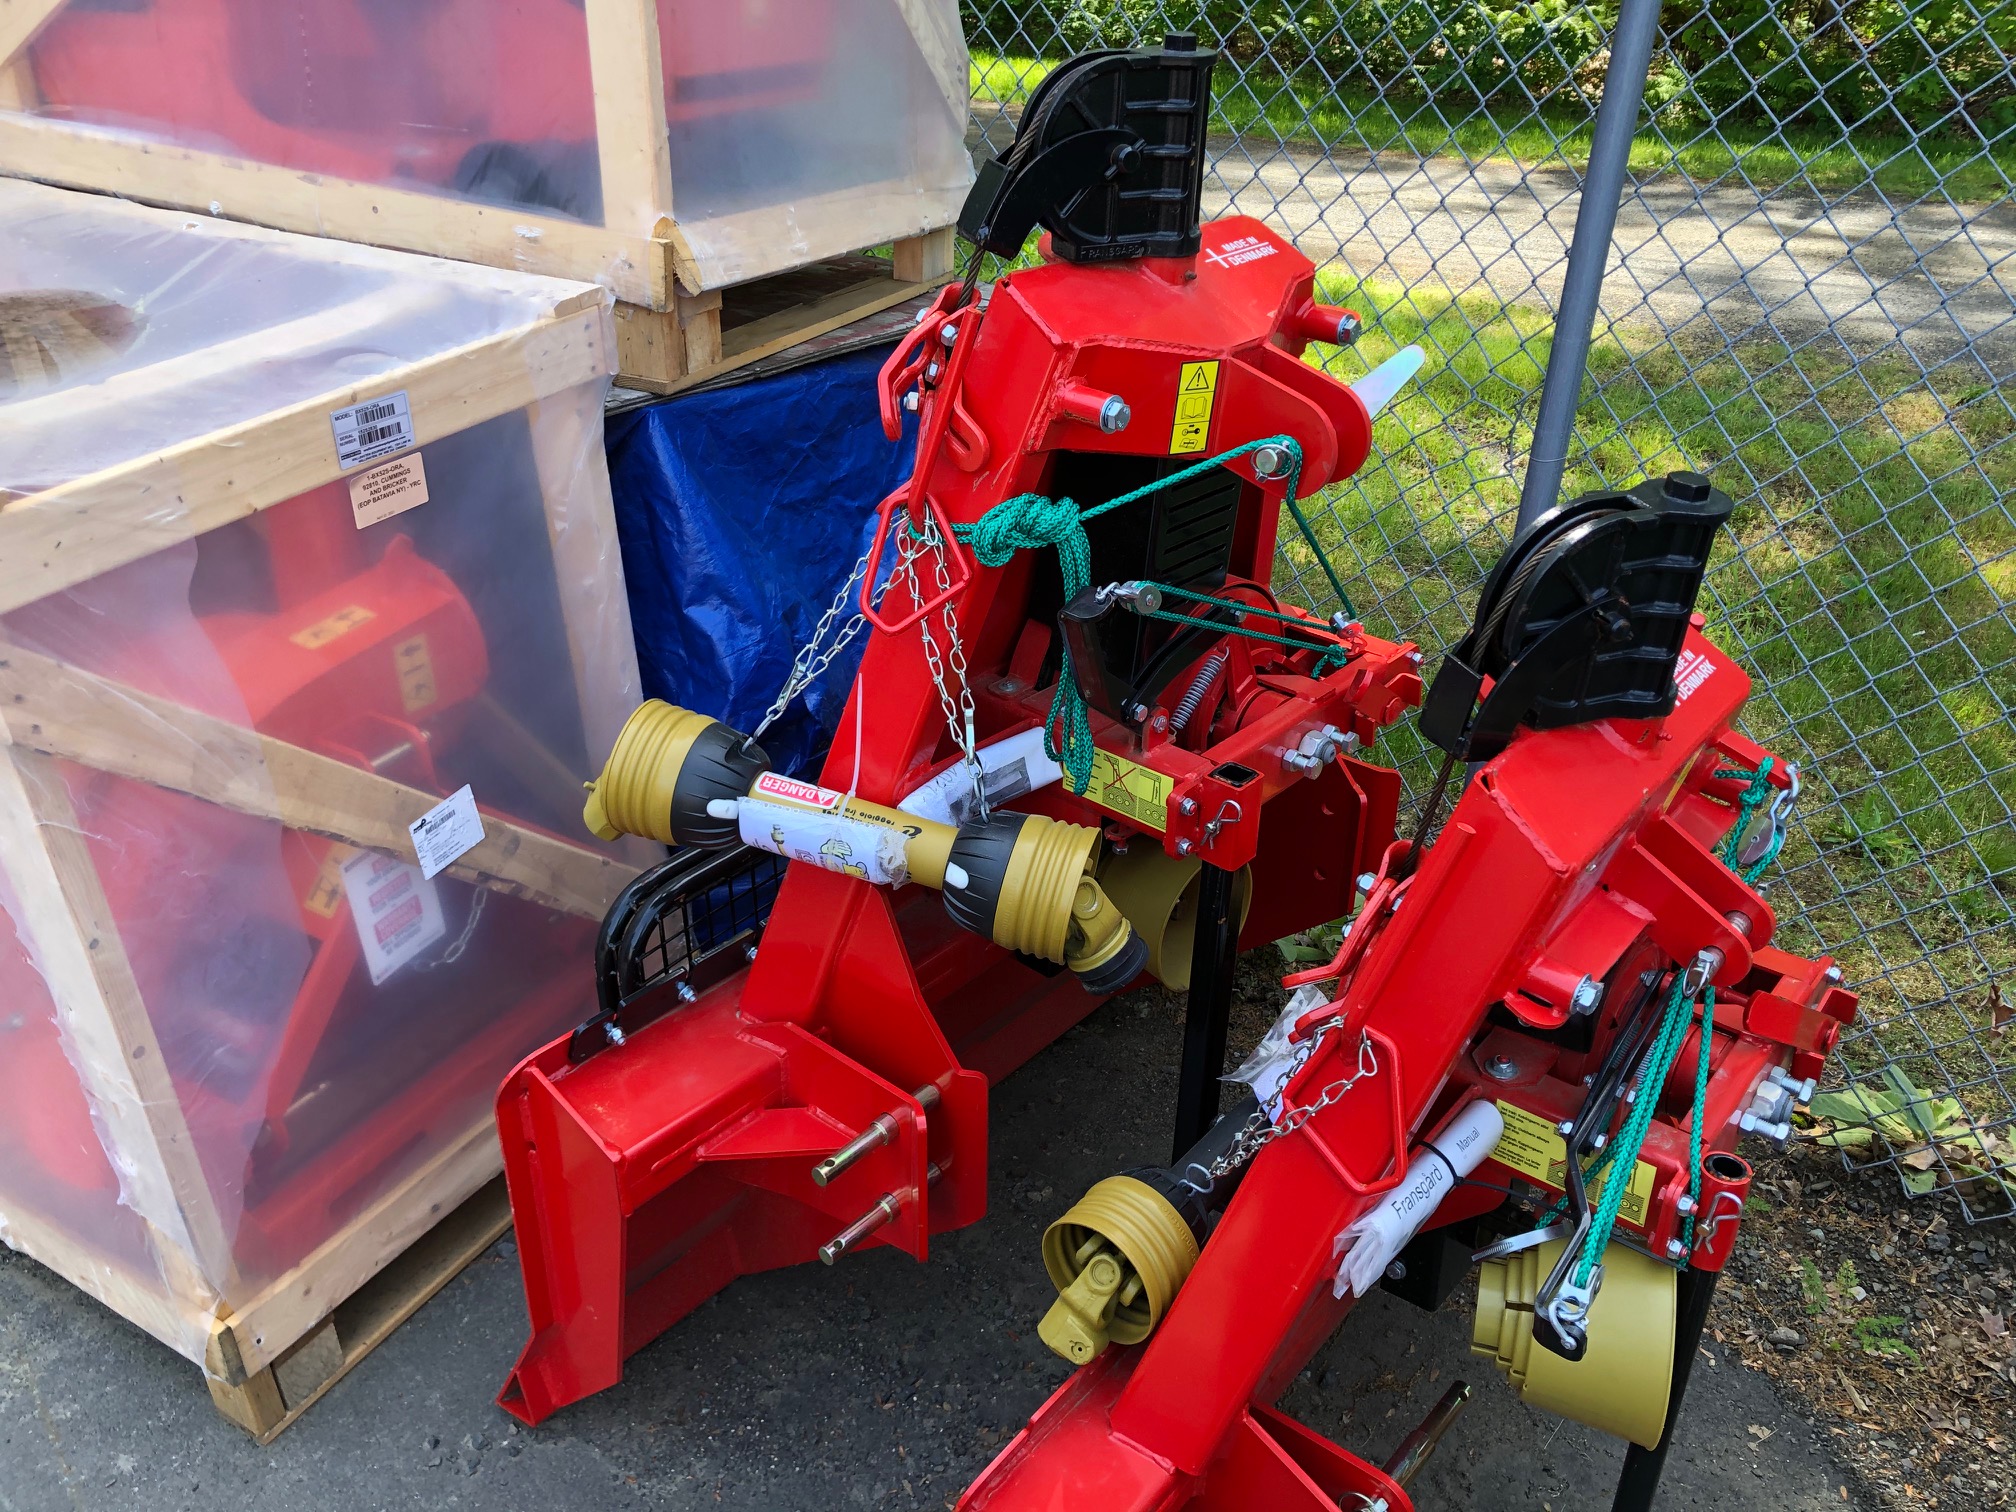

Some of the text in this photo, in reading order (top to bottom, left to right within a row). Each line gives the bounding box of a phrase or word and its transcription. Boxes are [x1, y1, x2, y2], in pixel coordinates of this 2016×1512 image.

[1221, 236, 1259, 252] MADE IN
[1227, 244, 1279, 266] DENMARK
[334, 412, 353, 421] MODEL:
[369, 477, 407, 496] AND BRICKER
[381, 468, 411, 486] CUMMINGS
[357, 498, 372, 511] (EOP
[372, 490, 396, 504] BATAVIA
[396, 486, 407, 495] NY)
[410, 479, 421, 490] YRC
[1682, 648, 1696, 662] IN
[1677, 658, 1717, 701] DENMARK
[760, 776, 817, 800] DANGER
[1455, 1126, 1480, 1152] Manual
[1391, 1163, 1443, 1219] Fransgård
